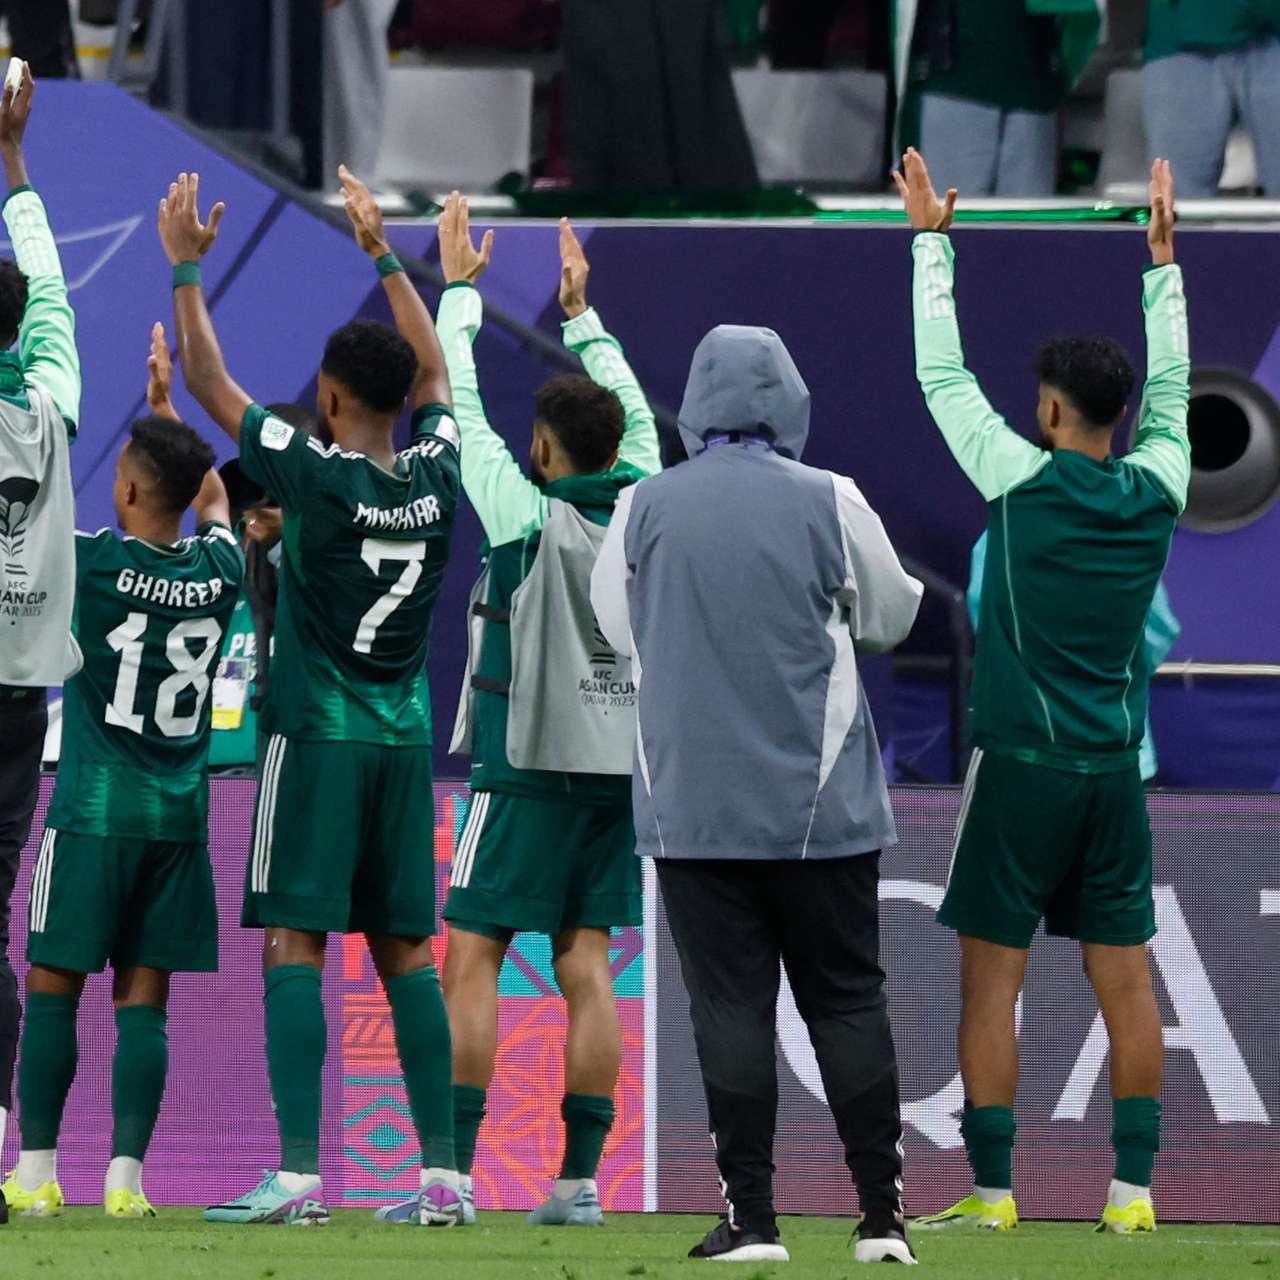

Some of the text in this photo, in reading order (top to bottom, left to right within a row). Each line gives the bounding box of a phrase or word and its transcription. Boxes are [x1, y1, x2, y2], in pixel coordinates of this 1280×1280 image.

[26, 592, 48, 605] CUP
[116, 568, 223, 608] GHAREEB
[352, 538, 427, 654] 7
[105, 612, 223, 737] 18
[774, 878, 1280, 1148] QA
